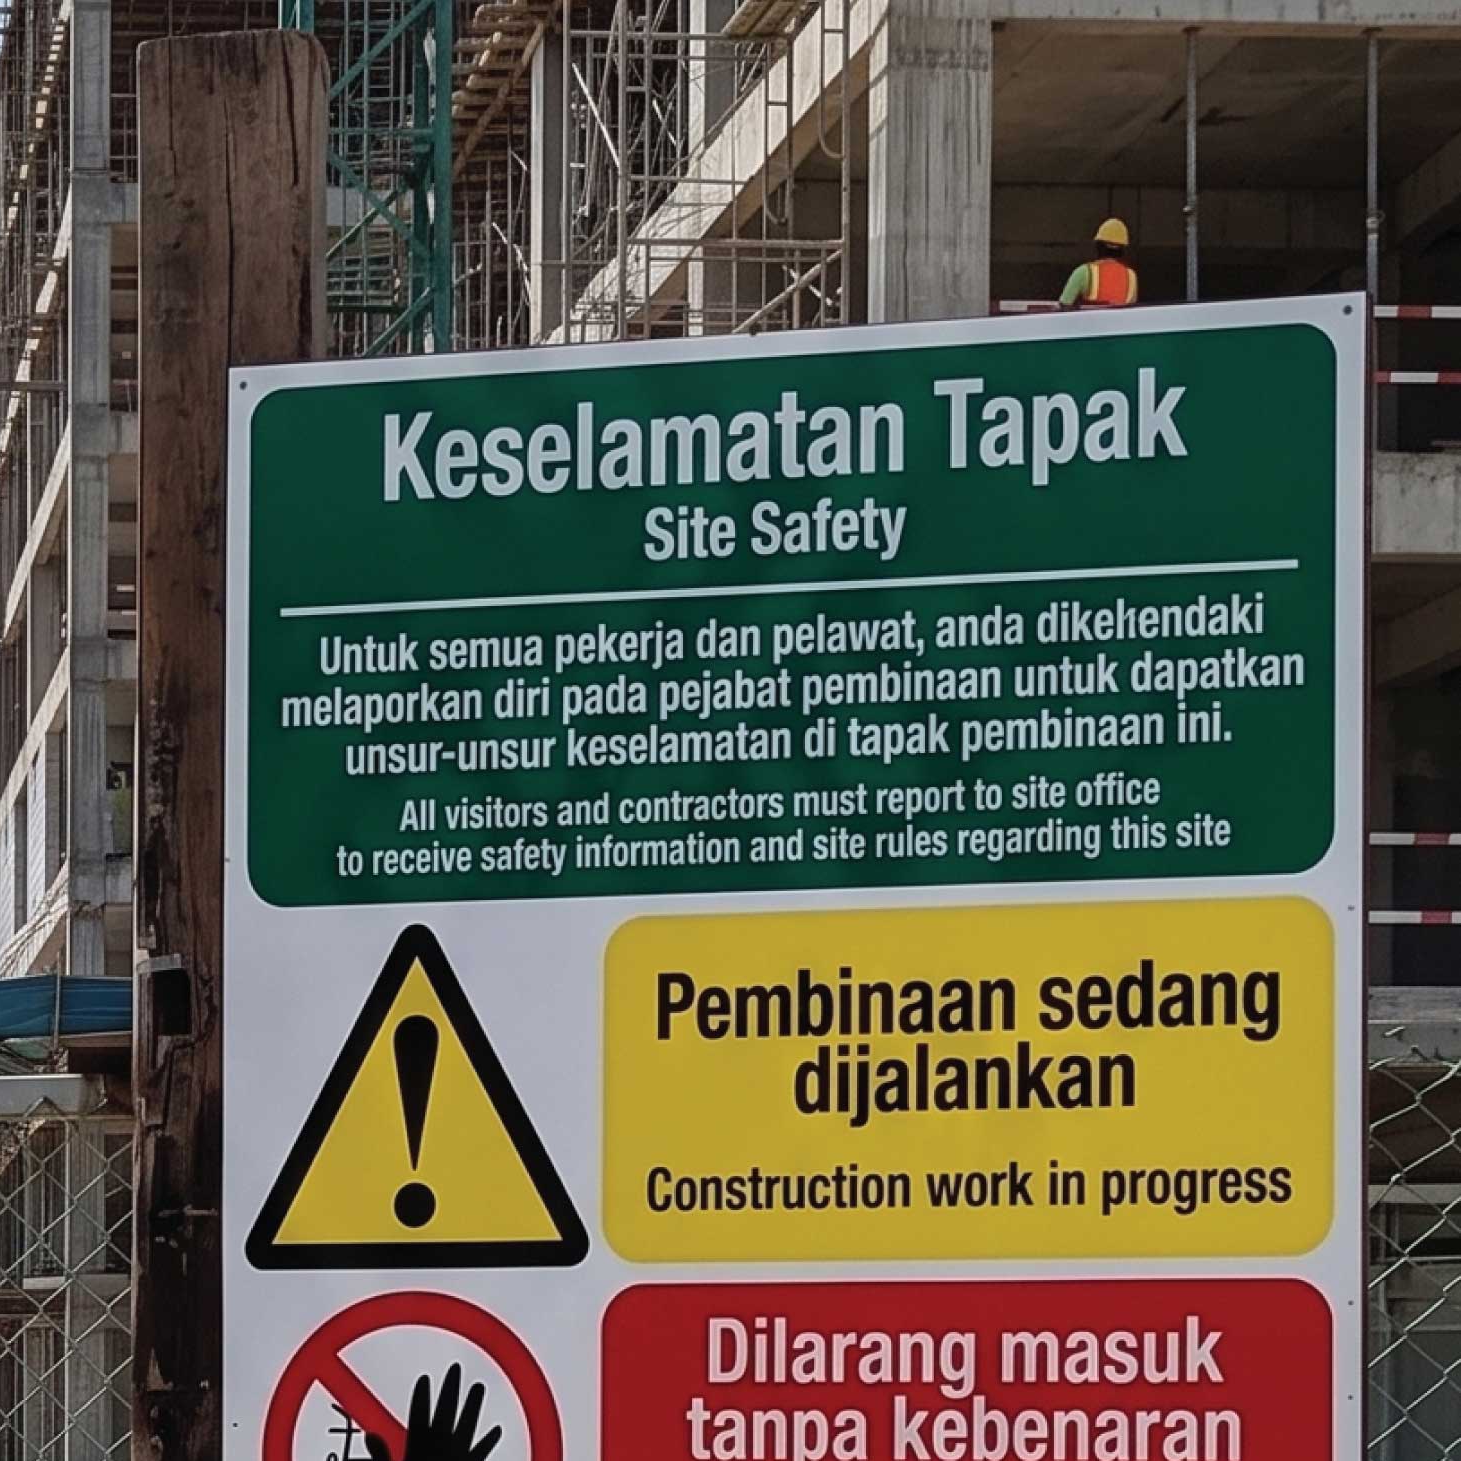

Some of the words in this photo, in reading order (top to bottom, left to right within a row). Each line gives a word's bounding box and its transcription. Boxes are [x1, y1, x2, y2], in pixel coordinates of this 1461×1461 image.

[384, 391, 904, 501] Keselamatan
[933, 367, 1188, 486] Tapak
[644, 505, 736, 561] Site
[751, 497, 907, 561] Safety
[320, 632, 419, 675] Untuk
[429, 635, 543, 670] semua
[555, 621, 684, 673] pekerja
[696, 618, 761, 659] dan
[773, 610, 924, 665] pelawat,
[935, 605, 1023, 648] anda
[1037, 592, 1263, 643] dikehendaki
[282, 682, 482, 733] melaporkan
[494, 677, 550, 718] diri
[562, 674, 647, 725] pada
[660, 668, 791, 720] pejabat
[802, 660, 1001, 715] pembinaan
[1014, 653, 1119, 697] untuk
[1130, 647, 1304, 700] dapatkan
[347, 737, 557, 775] unsur-unsur
[567, 722, 791, 766] keselamatan
[804, 716, 836, 758] di
[847, 713, 951, 765] tapak
[962, 707, 1164, 761] pembinaan
[1177, 700, 1232, 743] ini.
[399, 799, 435, 831] All
[444, 795, 548, 829] visitors
[557, 792, 609, 826] and
[619, 788, 784, 824] contractors
[793, 783, 867, 817] must
[876, 779, 966, 820] report
[973, 779, 1003, 811] to
[1012, 775, 1066, 809] site
[1076, 772, 1161, 807] office
[336, 845, 363, 876] to
[372, 847, 472, 876] receive
[481, 838, 567, 876] safety
[576, 831, 740, 868] information
[750, 828, 803, 863] and
[813, 827, 865, 860] site
[876, 824, 948, 858] rules
[958, 818, 1100, 861] regarding
[1110, 815, 1167, 849] this
[1175, 813, 1231, 847] site
[657, 966, 1016, 1041] Pembinaan
[1039, 958, 1280, 1042] sedang
[794, 1041, 1135, 1128] dijalankan
[646, 1163, 910, 1213] Construction
[926, 1161, 1034, 1207] work
[1049, 1159, 1085, 1206] in
[1102, 1166, 1292, 1216] progress
[708, 1317, 976, 1399] Dilarang
[1001, 1315, 1224, 1384] masuk
[894, 1395, 1241, 1461] kebenaran
